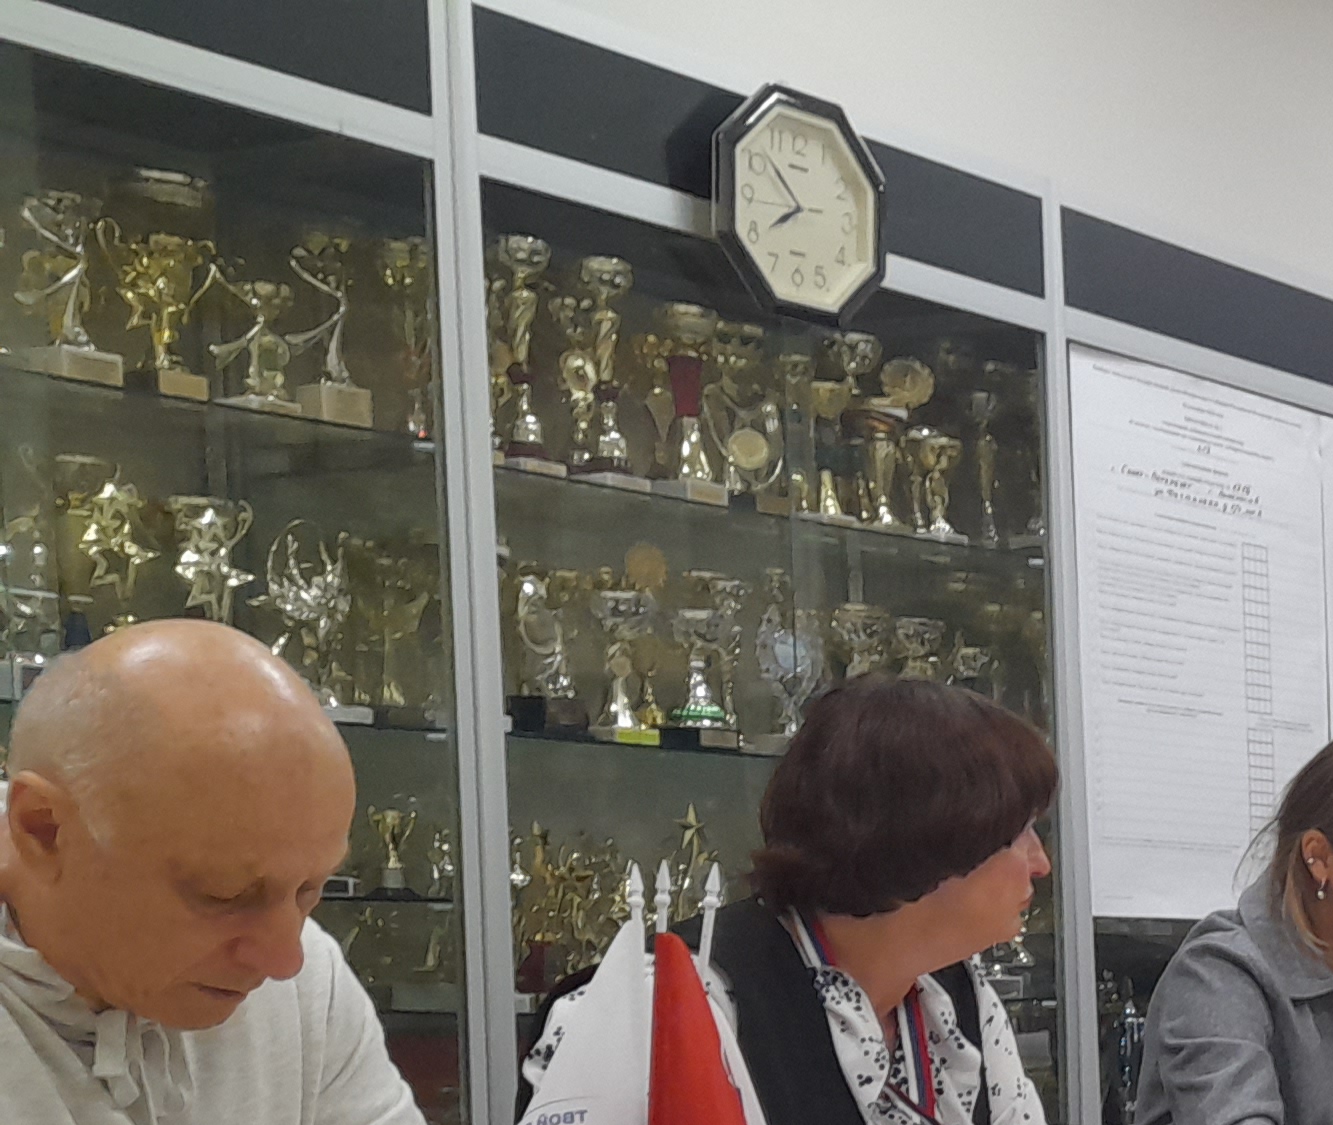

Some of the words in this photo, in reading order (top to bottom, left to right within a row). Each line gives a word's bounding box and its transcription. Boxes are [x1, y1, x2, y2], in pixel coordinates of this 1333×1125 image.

[769, 127, 783, 153] 11
[740, 183, 755, 205] 9
[747, 220, 760, 245] 8
[841, 211, 854, 236] 3
[767, 251, 780, 272] 7
[834, 245, 846, 267] 4
[790, 266, 804, 289] 6
[813, 265, 827, 290] 5
